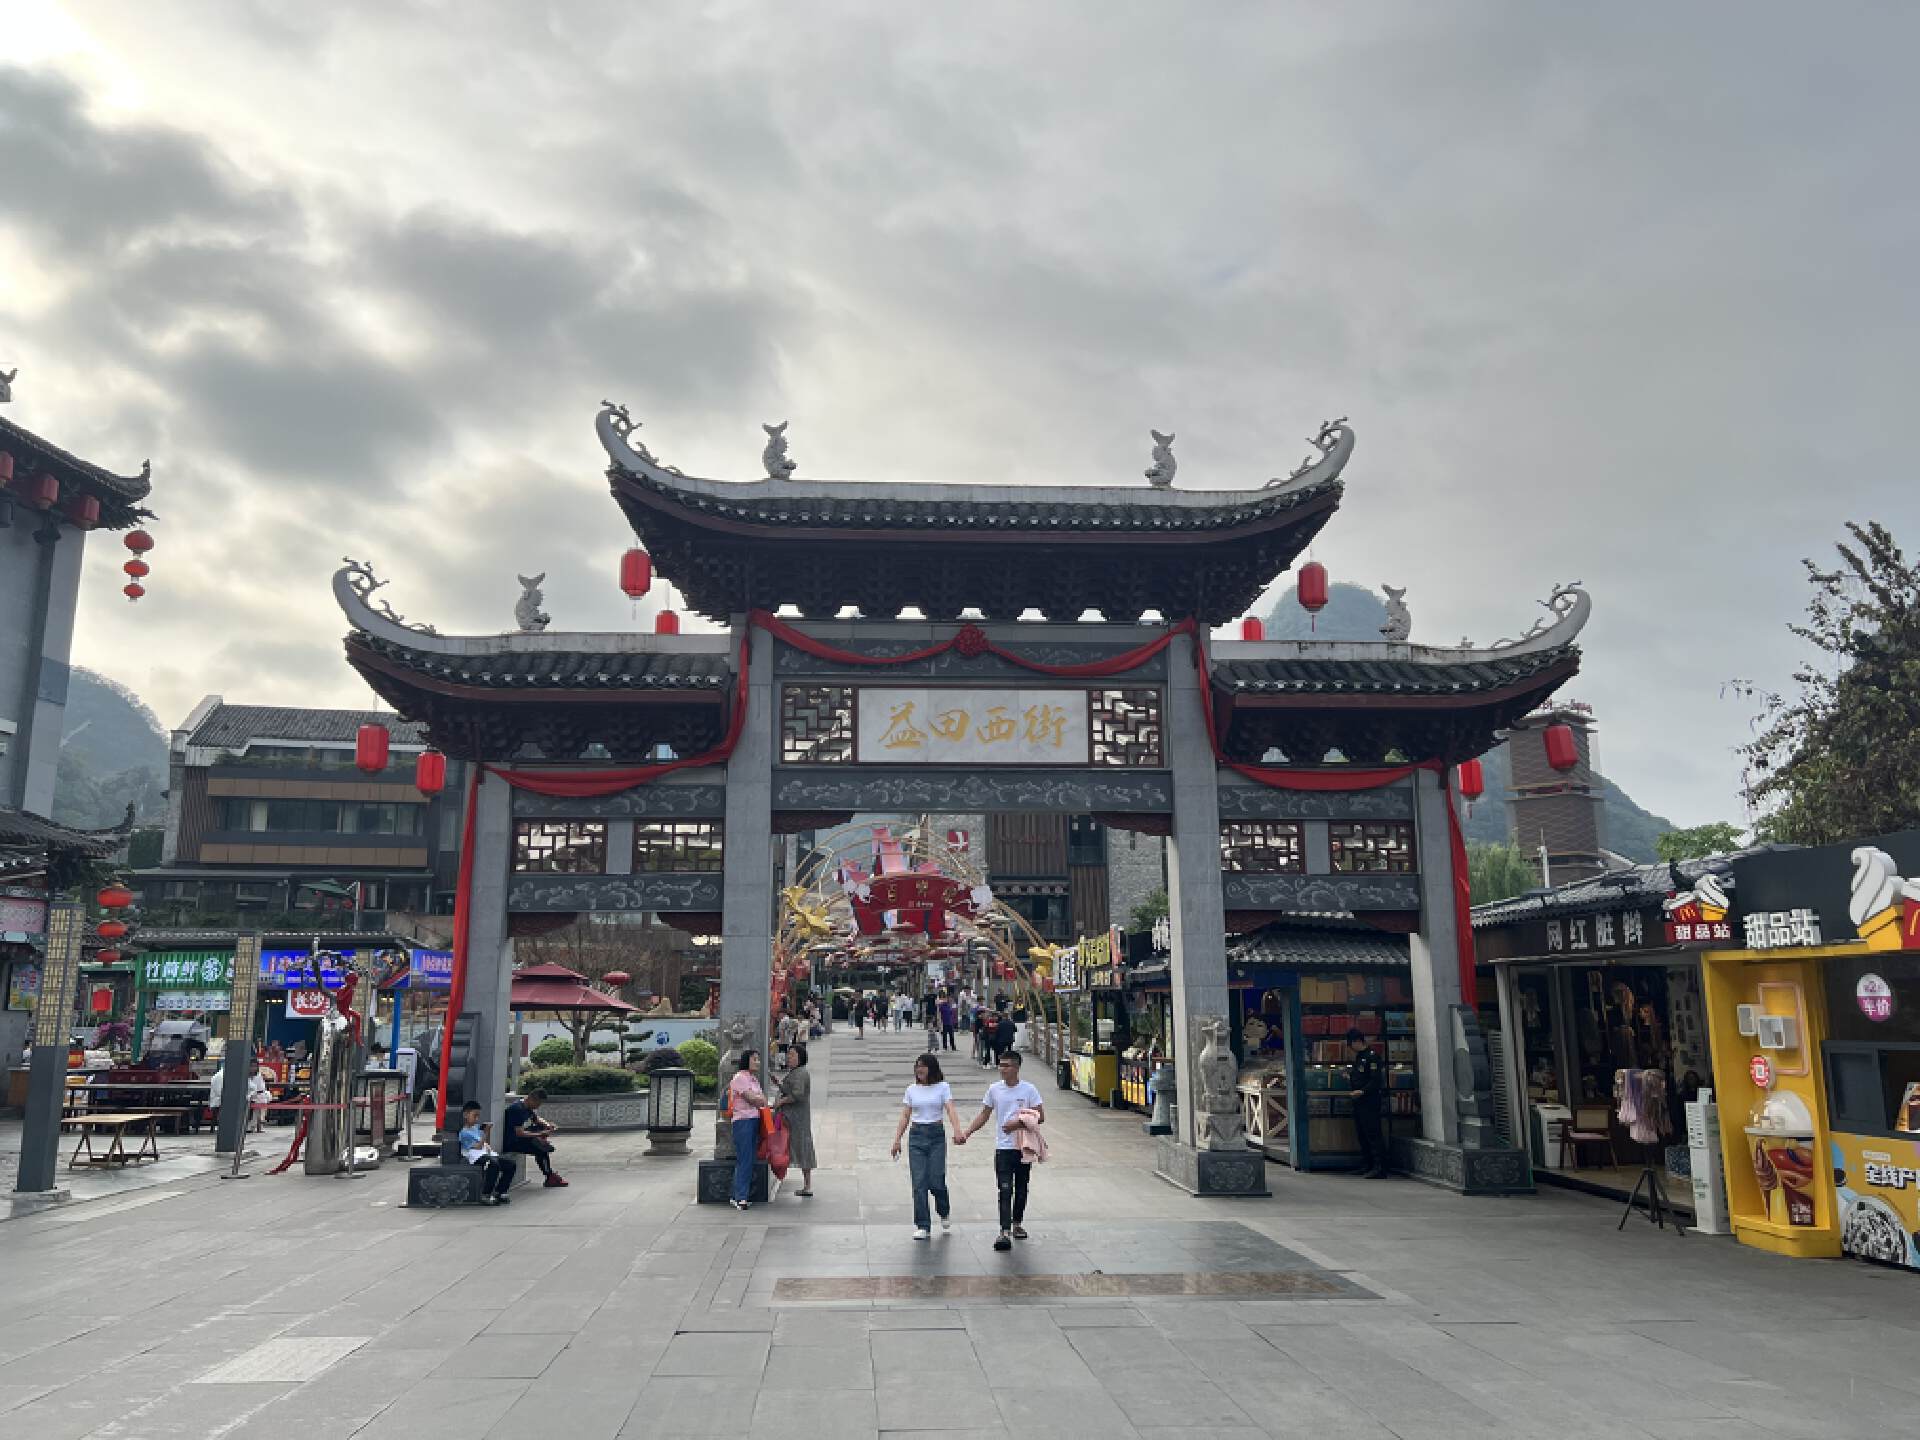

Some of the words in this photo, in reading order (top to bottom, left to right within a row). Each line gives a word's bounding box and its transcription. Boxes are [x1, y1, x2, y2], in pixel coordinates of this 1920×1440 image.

[878, 700, 1069, 749] 益田西街
[1546, 910, 1643, 951] 网红脏辫
[1675, 923, 1731, 940] 甜品站
[1743, 909, 1822, 949] 甜品站
